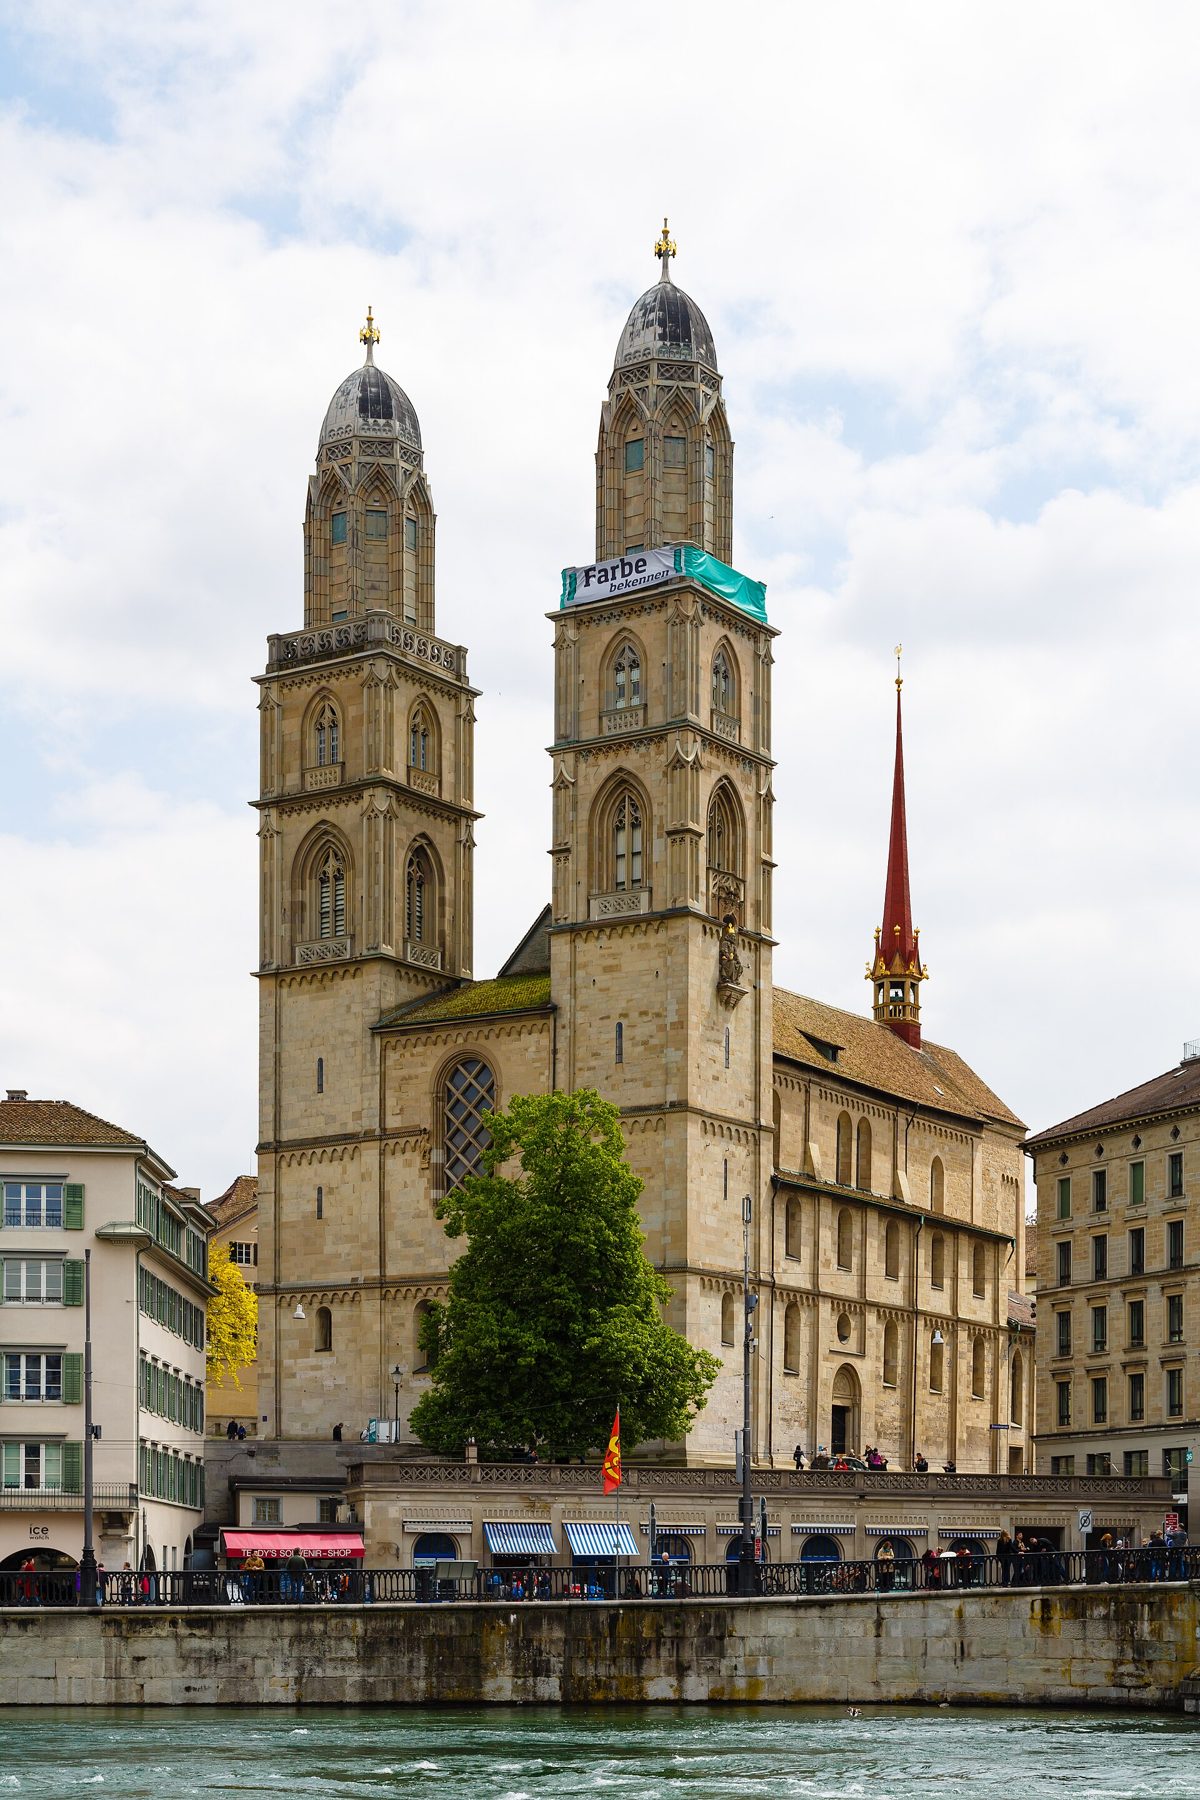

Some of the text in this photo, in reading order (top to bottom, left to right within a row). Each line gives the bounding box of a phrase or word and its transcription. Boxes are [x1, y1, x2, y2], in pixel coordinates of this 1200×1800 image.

[584, 558, 647, 587] Farbe
[609, 569, 669, 592] bekennen
[29, 1523, 49, 1535] ice
[241, 1549, 277, 1558] TEDY'S
